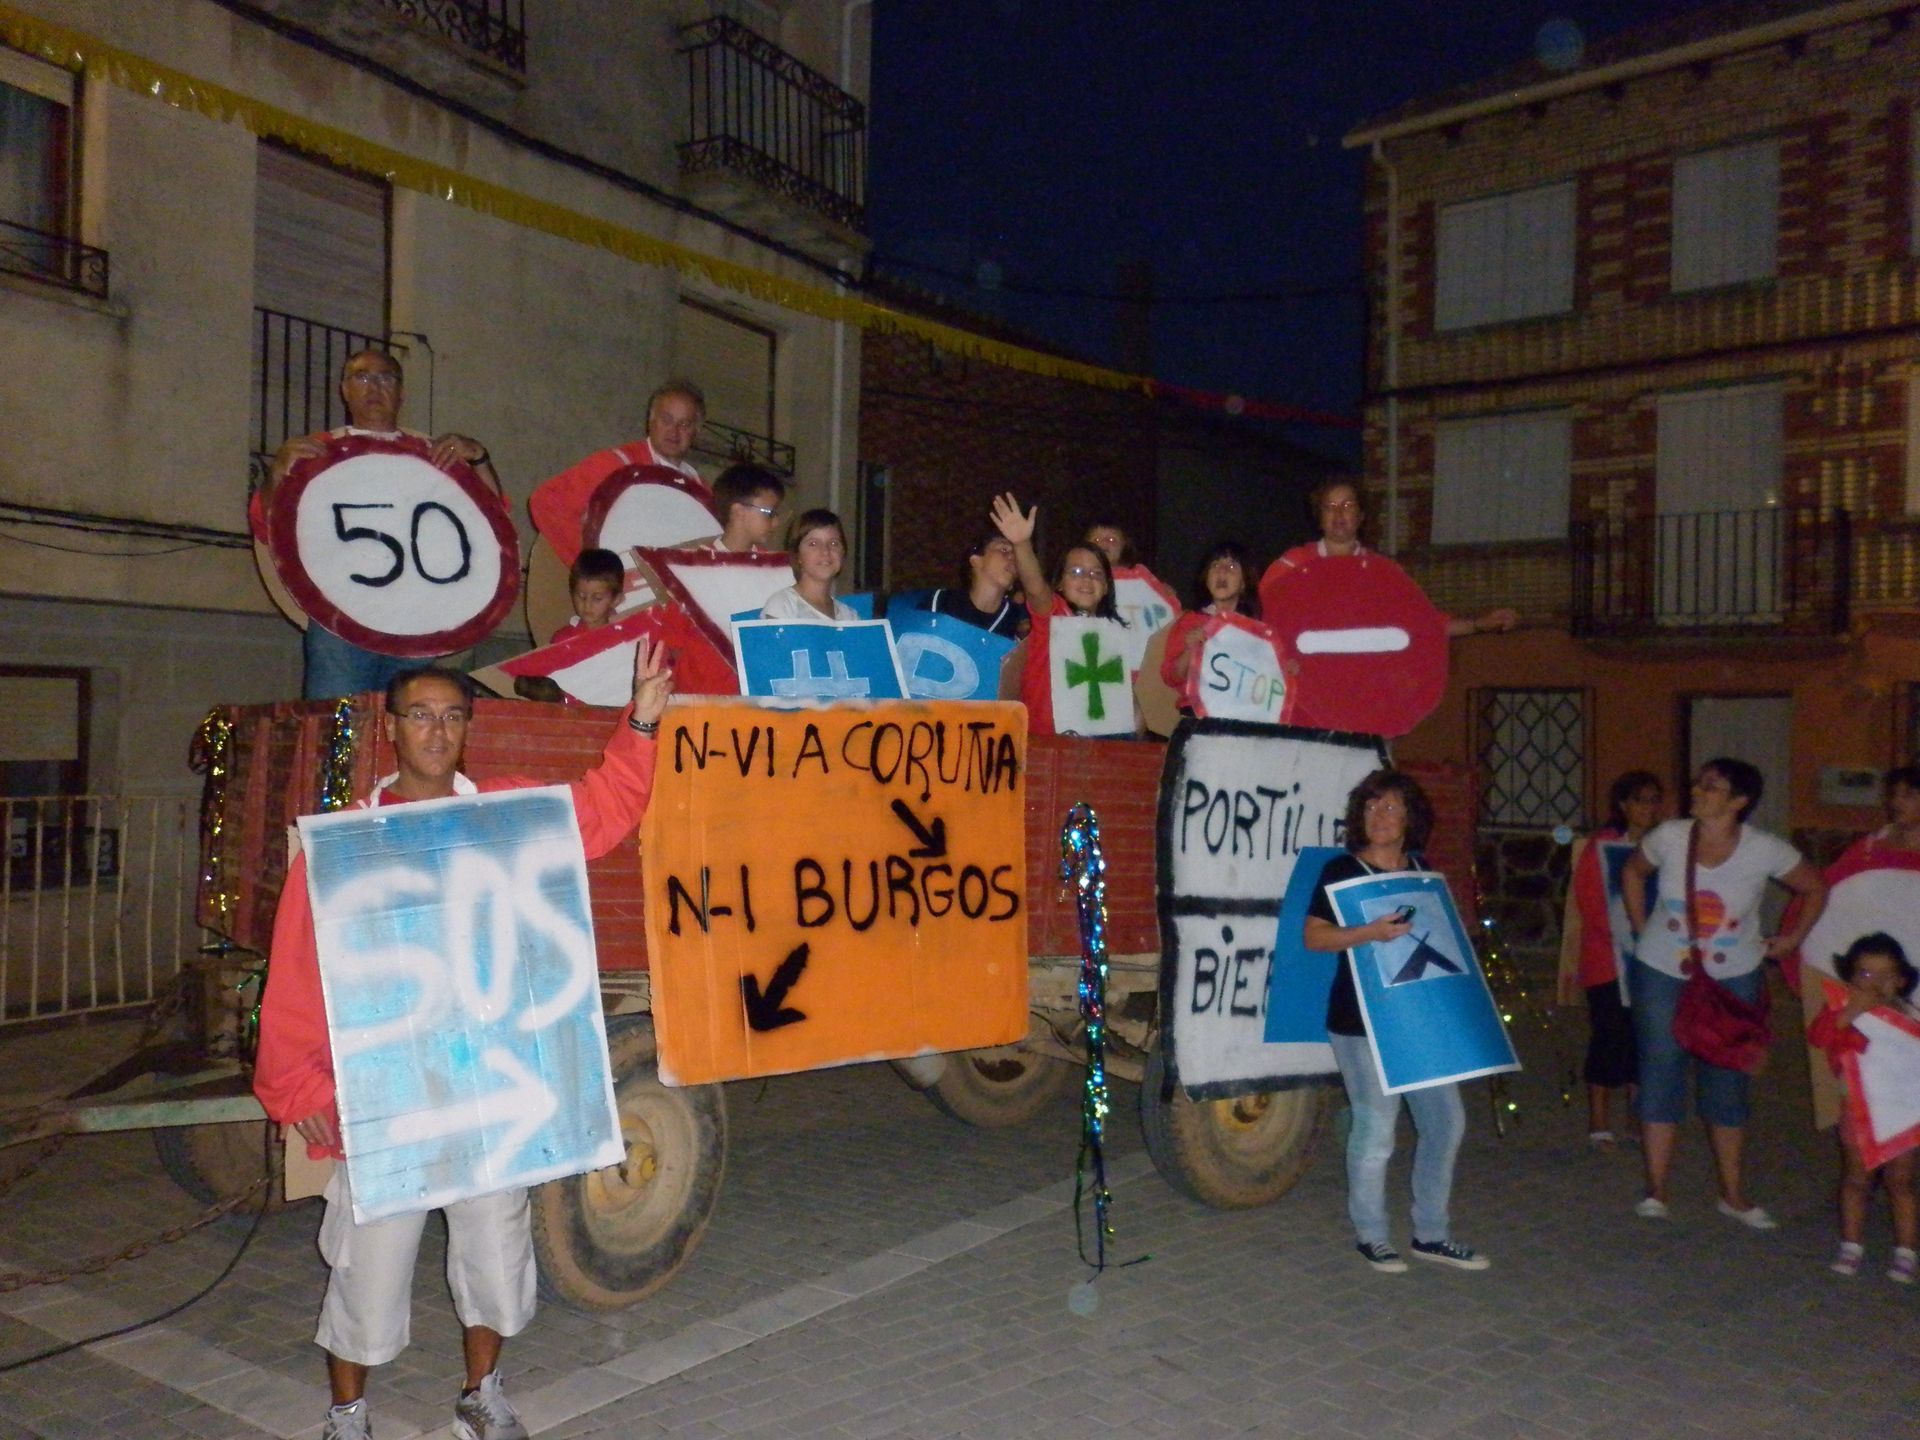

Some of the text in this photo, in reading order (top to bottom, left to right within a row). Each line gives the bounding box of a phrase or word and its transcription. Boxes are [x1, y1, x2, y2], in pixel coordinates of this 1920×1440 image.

[332, 501, 471, 588] 50
[1119, 603, 1168, 631] TOP
[1208, 652, 1285, 712] STOP
[674, 721, 775, 778] N-VI
[793, 723, 829, 779] A
[667, 856, 1021, 937] N-I BURGOS
[315, 840, 592, 1055] SOS
